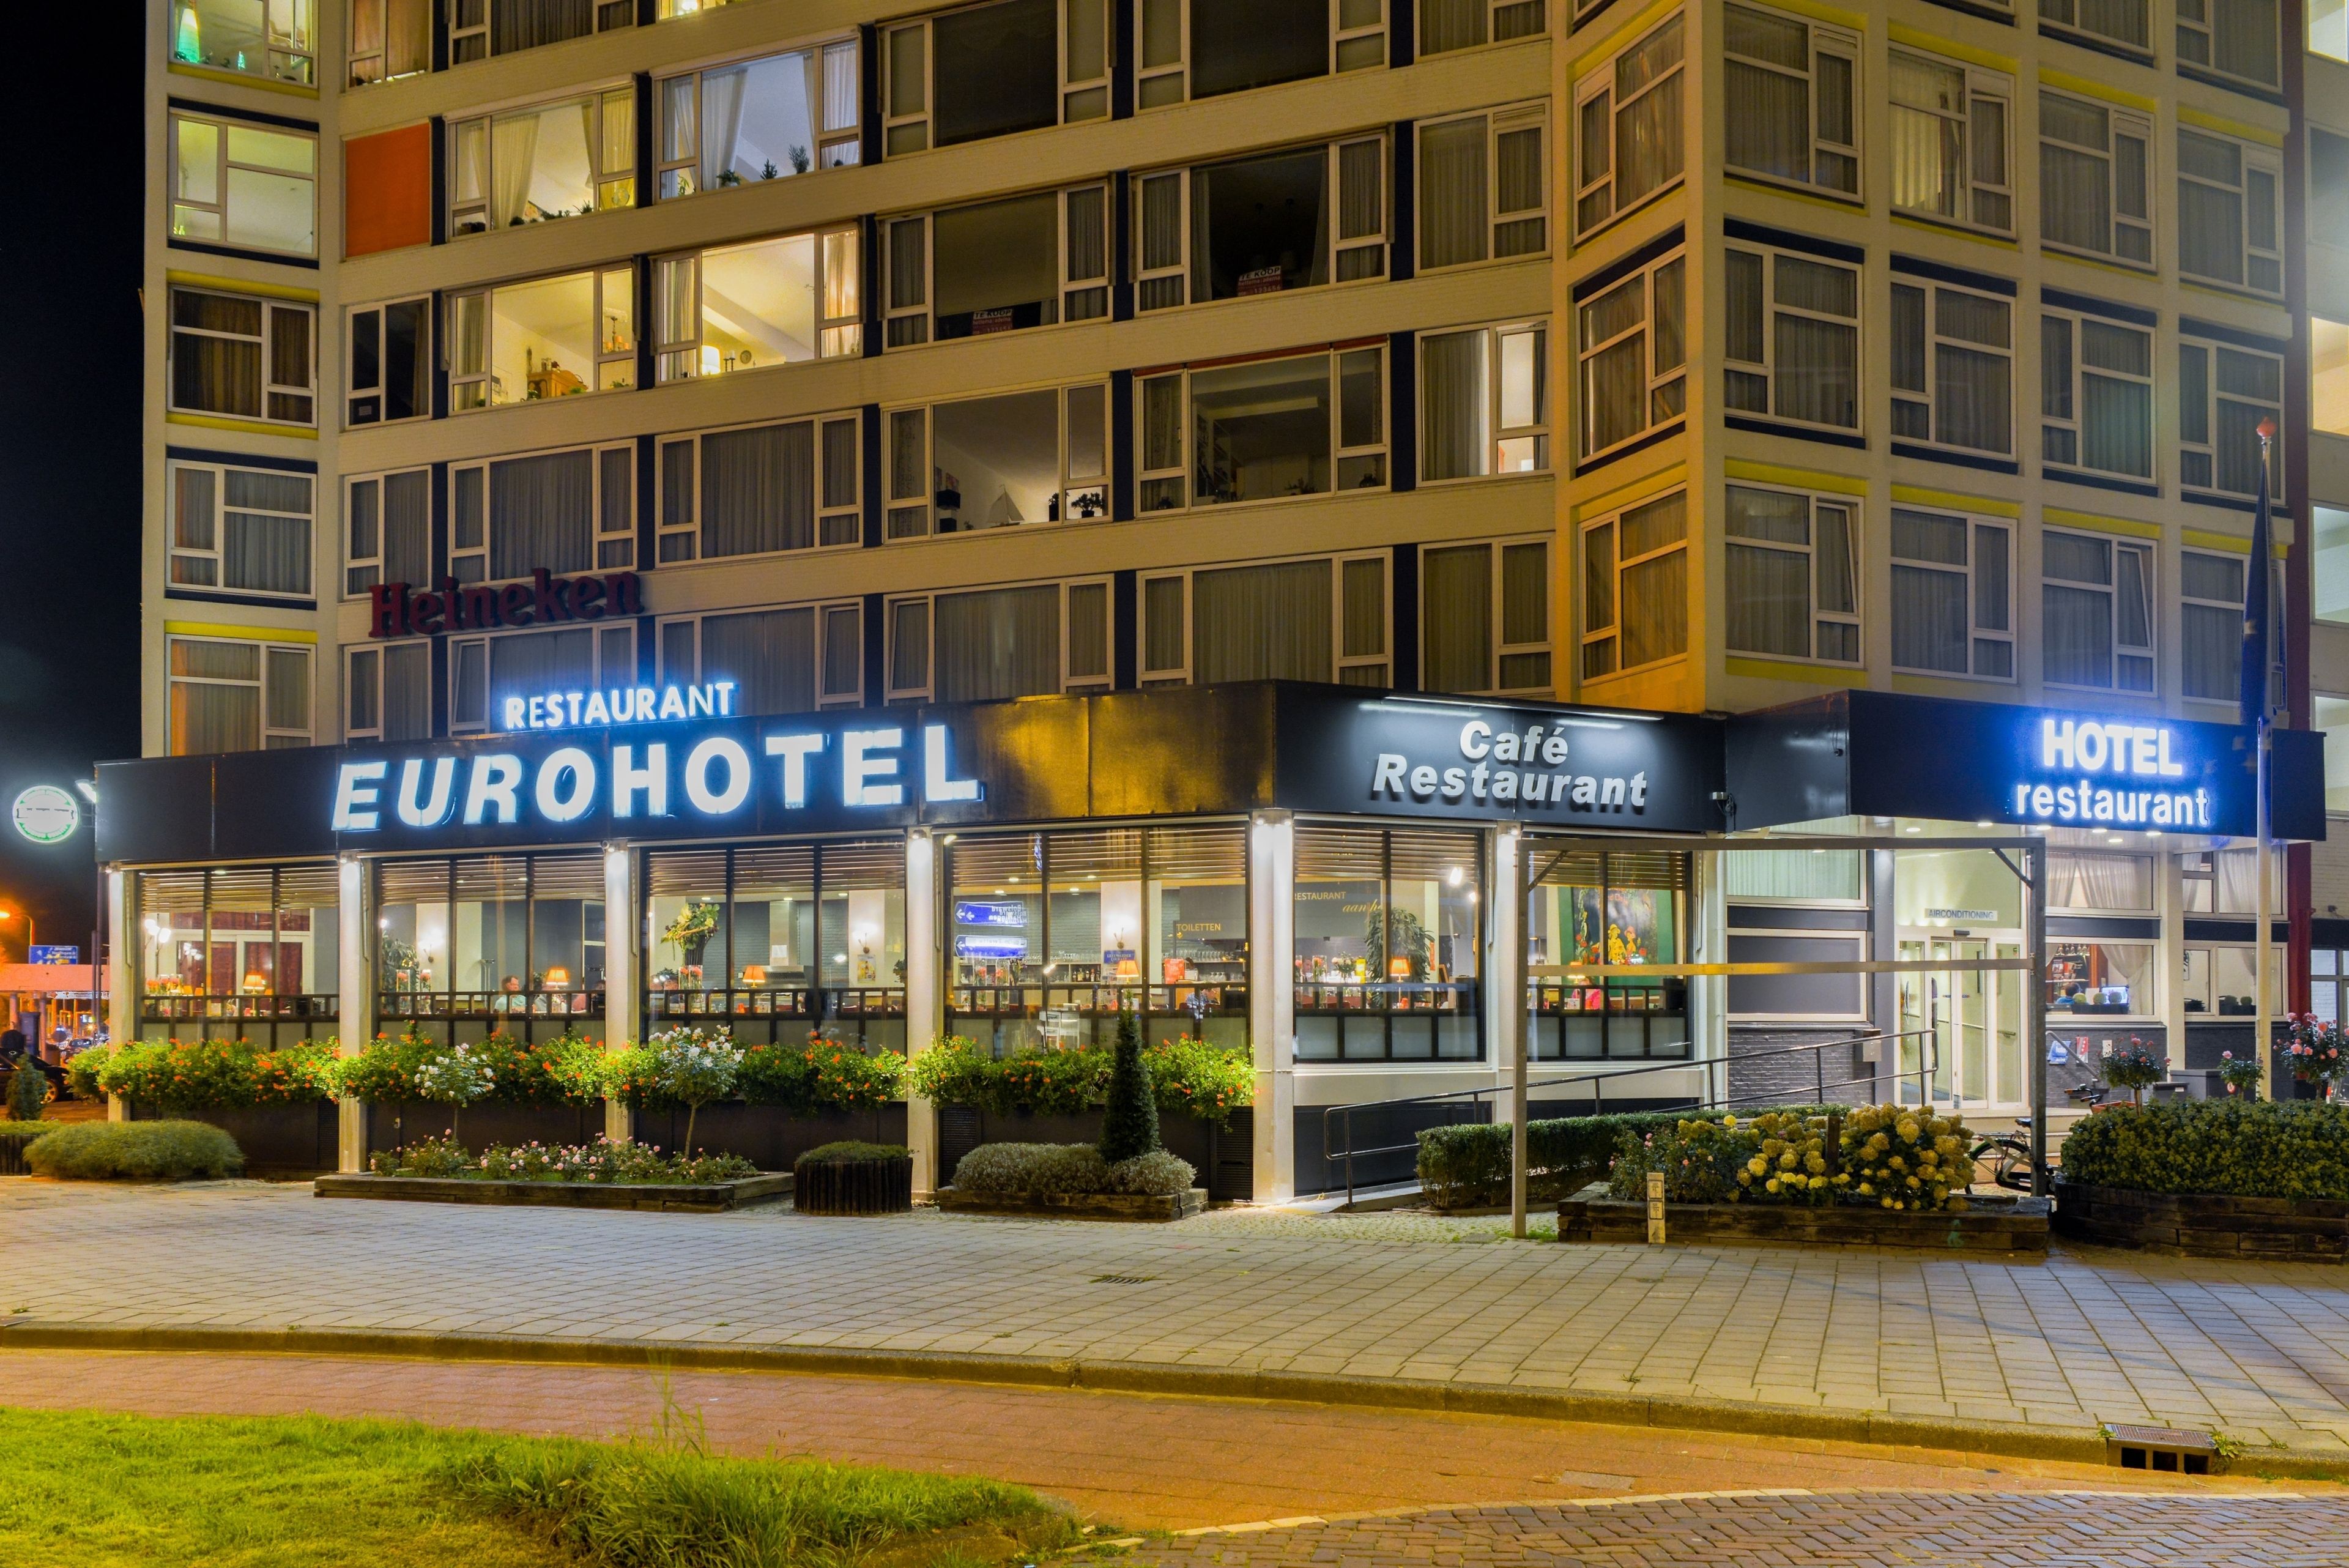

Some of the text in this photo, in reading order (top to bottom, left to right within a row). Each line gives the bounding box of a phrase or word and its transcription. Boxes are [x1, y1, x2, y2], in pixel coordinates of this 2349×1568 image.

[1254, 267, 1280, 278] KOOP
[369, 568, 645, 638] Heineken
[505, 682, 735, 729] RESTAURANT
[1460, 720, 1569, 764] Café
[2044, 719, 2183, 775] HOTEL
[331, 724, 984, 831] EUROHOTEL
[1373, 753, 1647, 807] Restaurant
[2017, 780, 2209, 826] restaurant
[1176, 923, 1222, 932] TOILETTEN
[1928, 909, 1994, 920] AIRCONDITIONING
